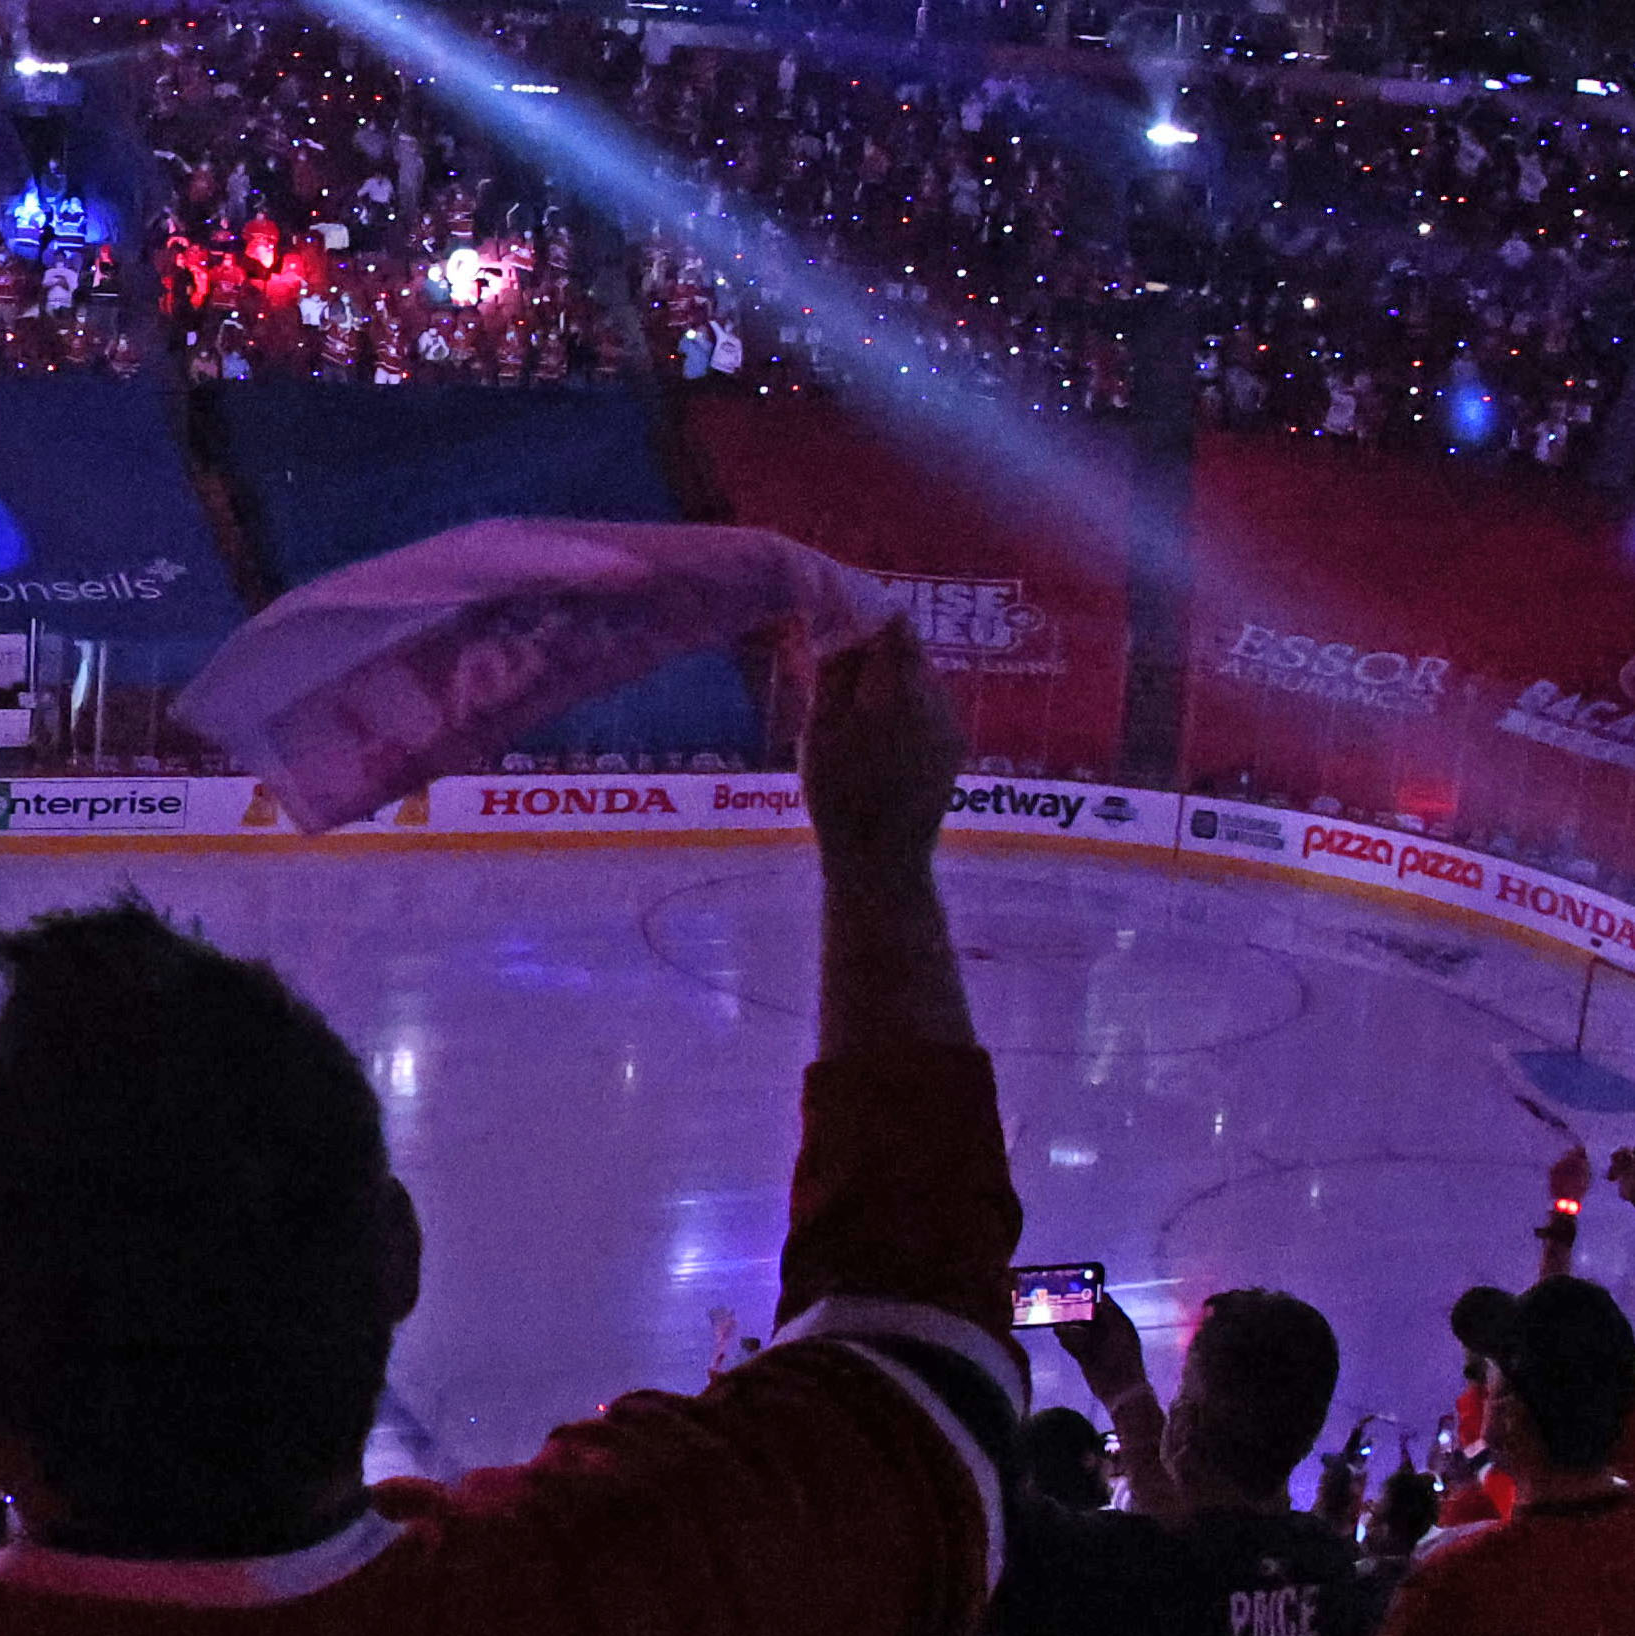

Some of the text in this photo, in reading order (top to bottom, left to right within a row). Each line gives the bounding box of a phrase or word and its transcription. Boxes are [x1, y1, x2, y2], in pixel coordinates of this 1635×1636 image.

[1231, 623, 1450, 694] ESSOR
[480, 787, 677, 816] HONDA
[713, 784, 801, 816] Banqu
[1495, 874, 1635, 951] HONDA
